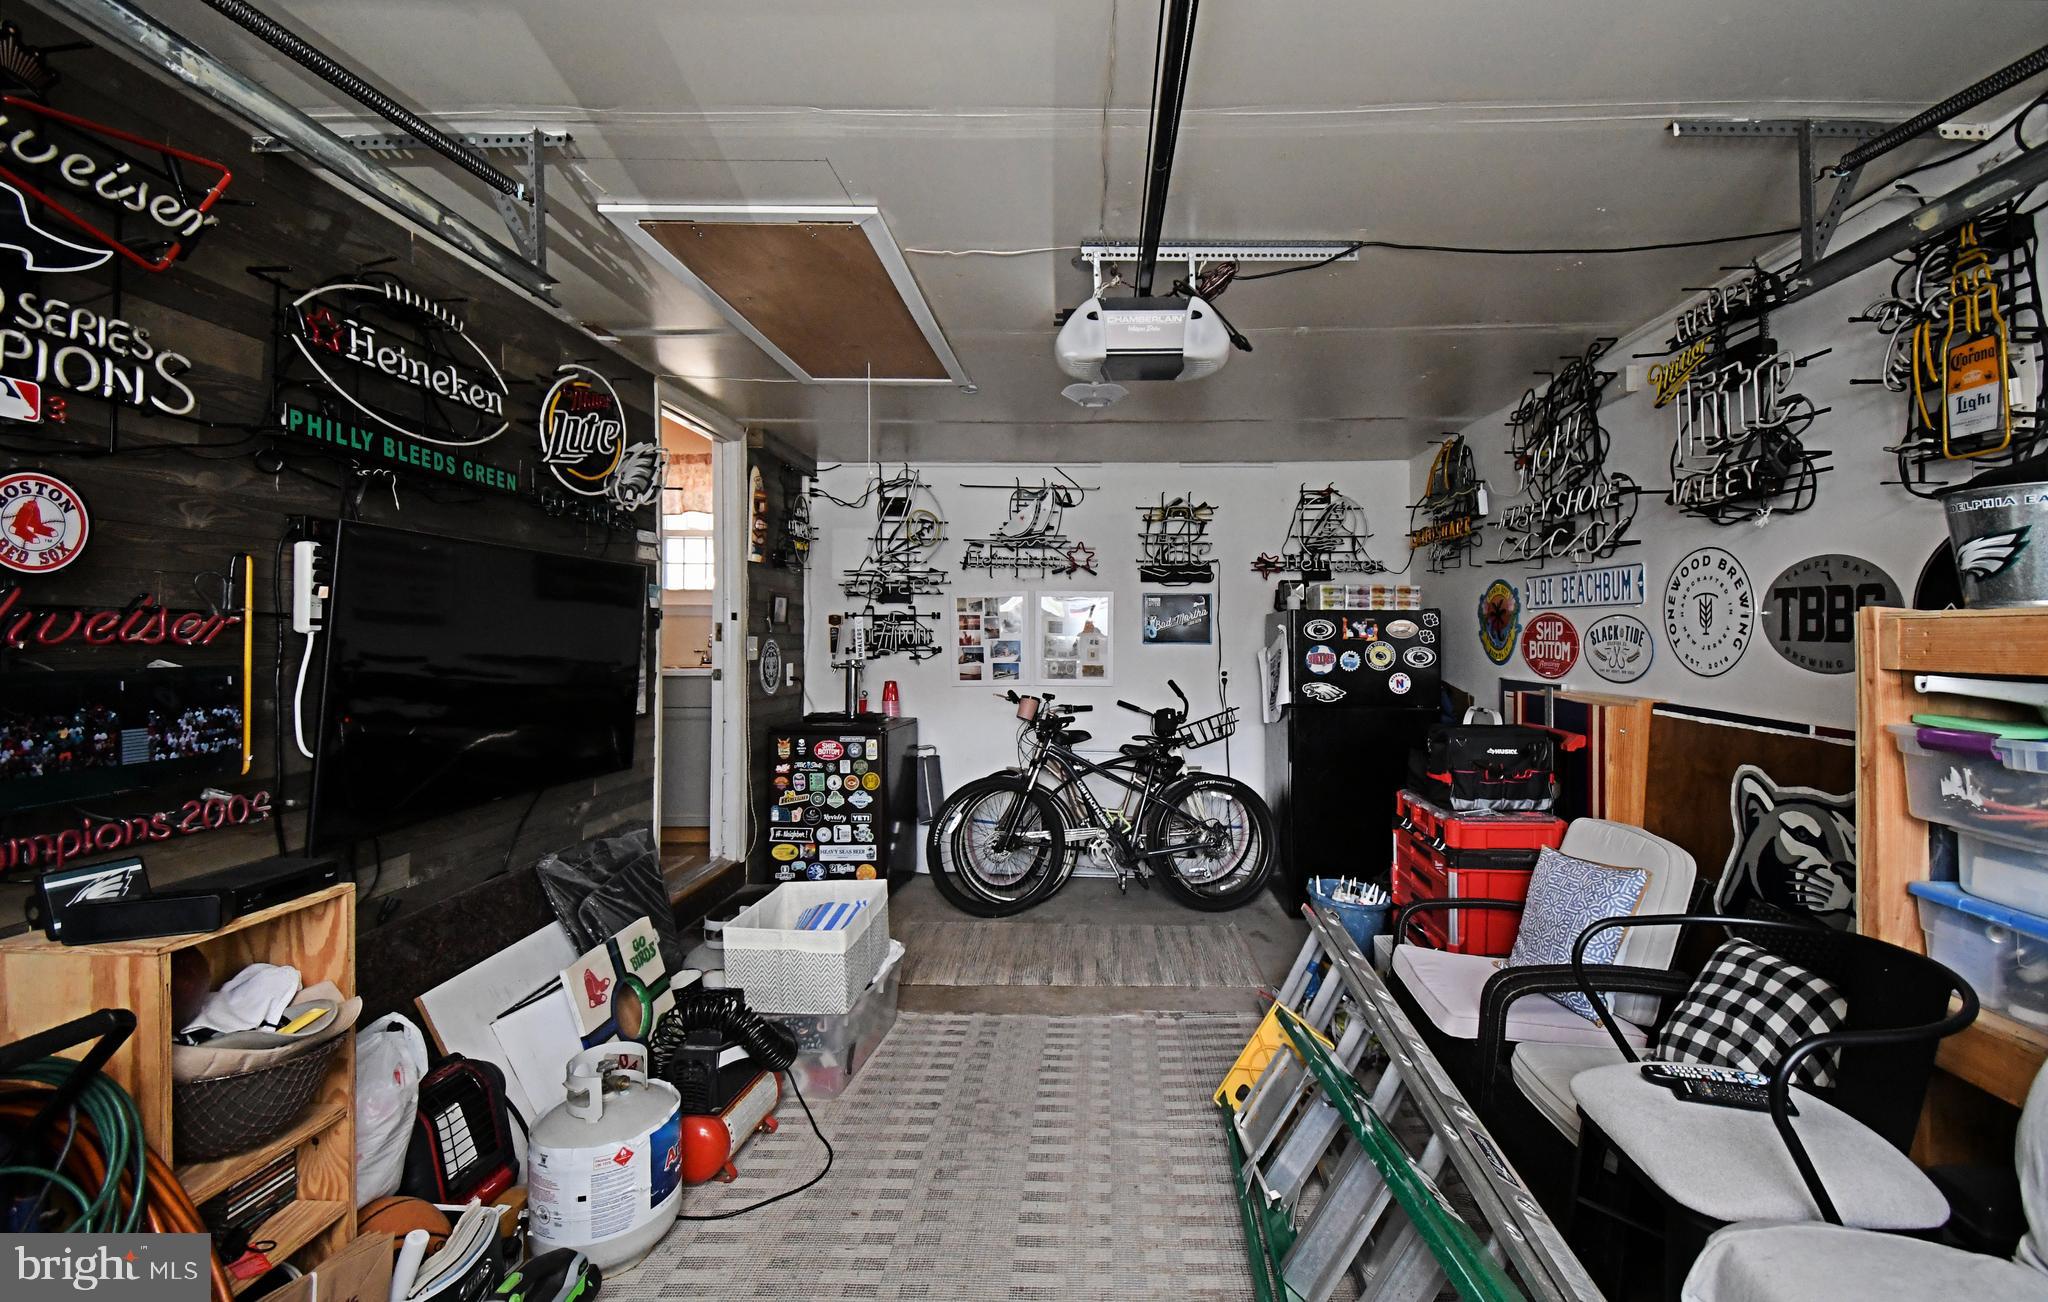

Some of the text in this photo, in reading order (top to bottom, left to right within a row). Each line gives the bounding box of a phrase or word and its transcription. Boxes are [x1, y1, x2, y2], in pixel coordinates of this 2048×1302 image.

[1107, 314, 1183, 324] CHAMBERLAIN
[1674, 275, 1757, 343] HAPPY
[14, 292, 154, 360] SERIES
[341, 317, 503, 418] Heineken
[1647, 336, 1712, 402] Miller
[1950, 346, 1995, 371] Corona
[1955, 392, 1992, 415] Light
[290, 409, 517, 492] PHILLY BLEEDS GREEN
[543, 409, 621, 463] Lite
[1673, 459, 1760, 505] VALLEY
[1553, 479, 1625, 520] SHORE
[39, 541, 72, 565] SOX
[1785, 560, 1870, 582] TAMPA BAY
[1534, 578, 1553, 606] LBI
[1562, 570, 1633, 603] BEACHBUM
[1667, 555, 1750, 651] TONEWOOD BREWING
[1536, 621, 1564, 641] SHIP
[1590, 624, 1645, 648] SLACK TIDE
[1529, 640, 1571, 662] BOTTOM
[1784, 646, 1844, 669] BREWING
[1076, 780, 1111, 829] cannondale
[629, 941, 657, 972] BIRDS
[632, 935, 645, 952] GO
